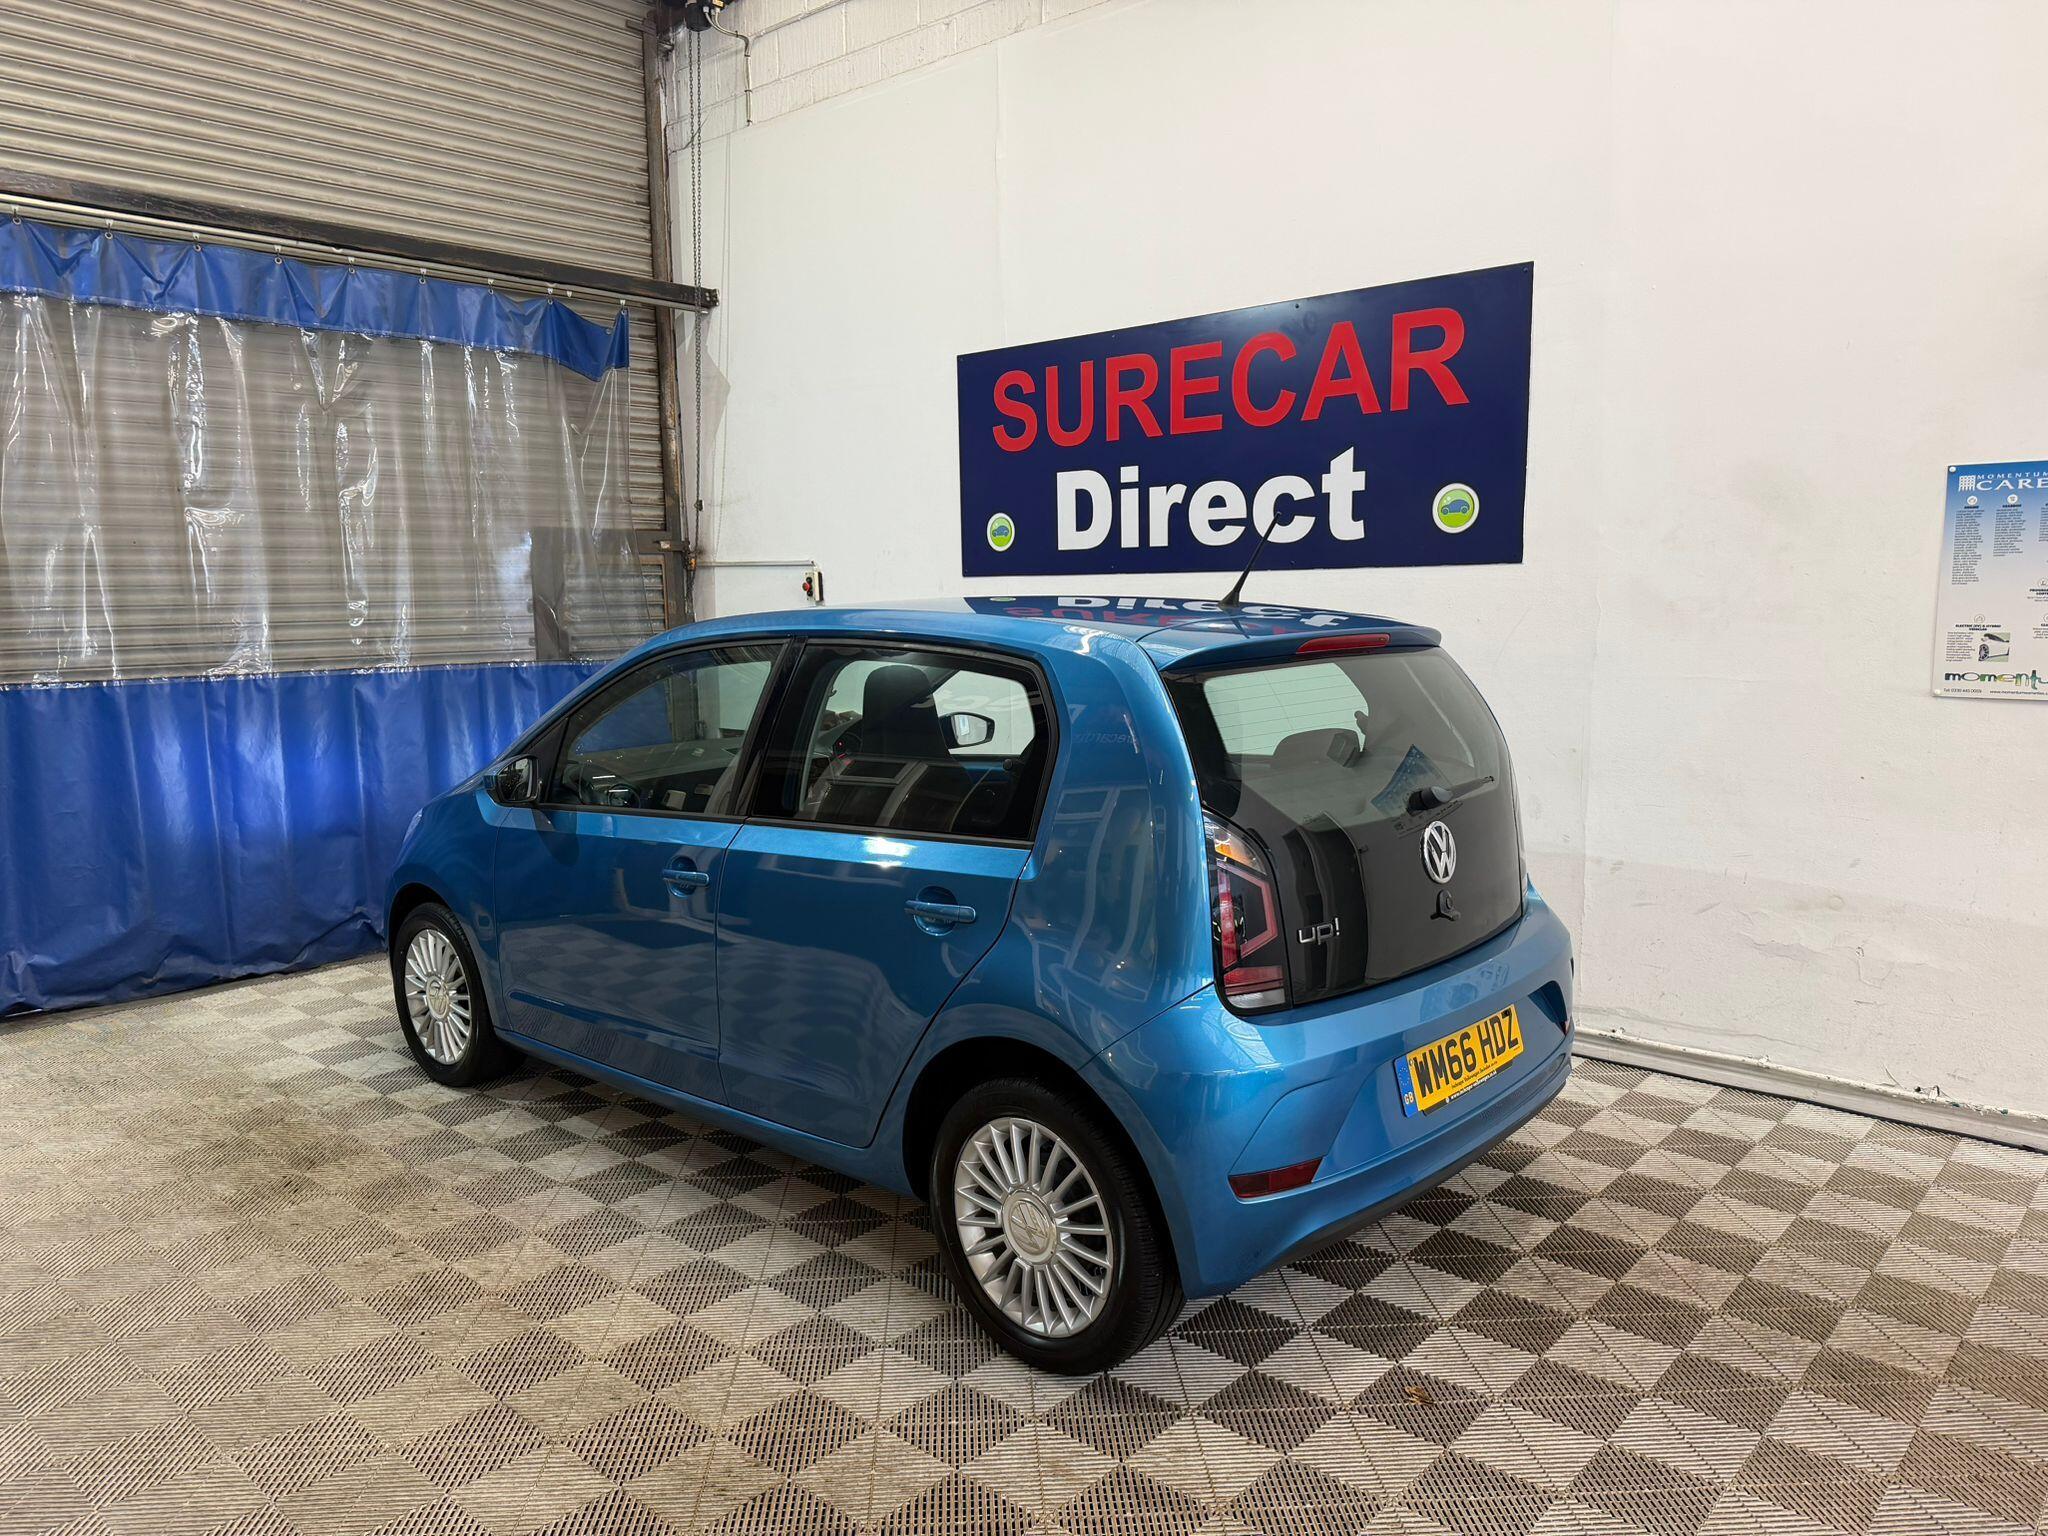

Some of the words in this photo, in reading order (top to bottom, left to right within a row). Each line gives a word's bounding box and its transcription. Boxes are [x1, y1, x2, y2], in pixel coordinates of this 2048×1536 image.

[991, 307, 1469, 453] SURECAR
[1056, 446, 1367, 552] Direct
[1298, 917, 1340, 945] up!
[1403, 1091, 1415, 1105] GB
[1411, 1031, 1477, 1098] WM66
[1476, 1007, 1519, 1064] HDZ
